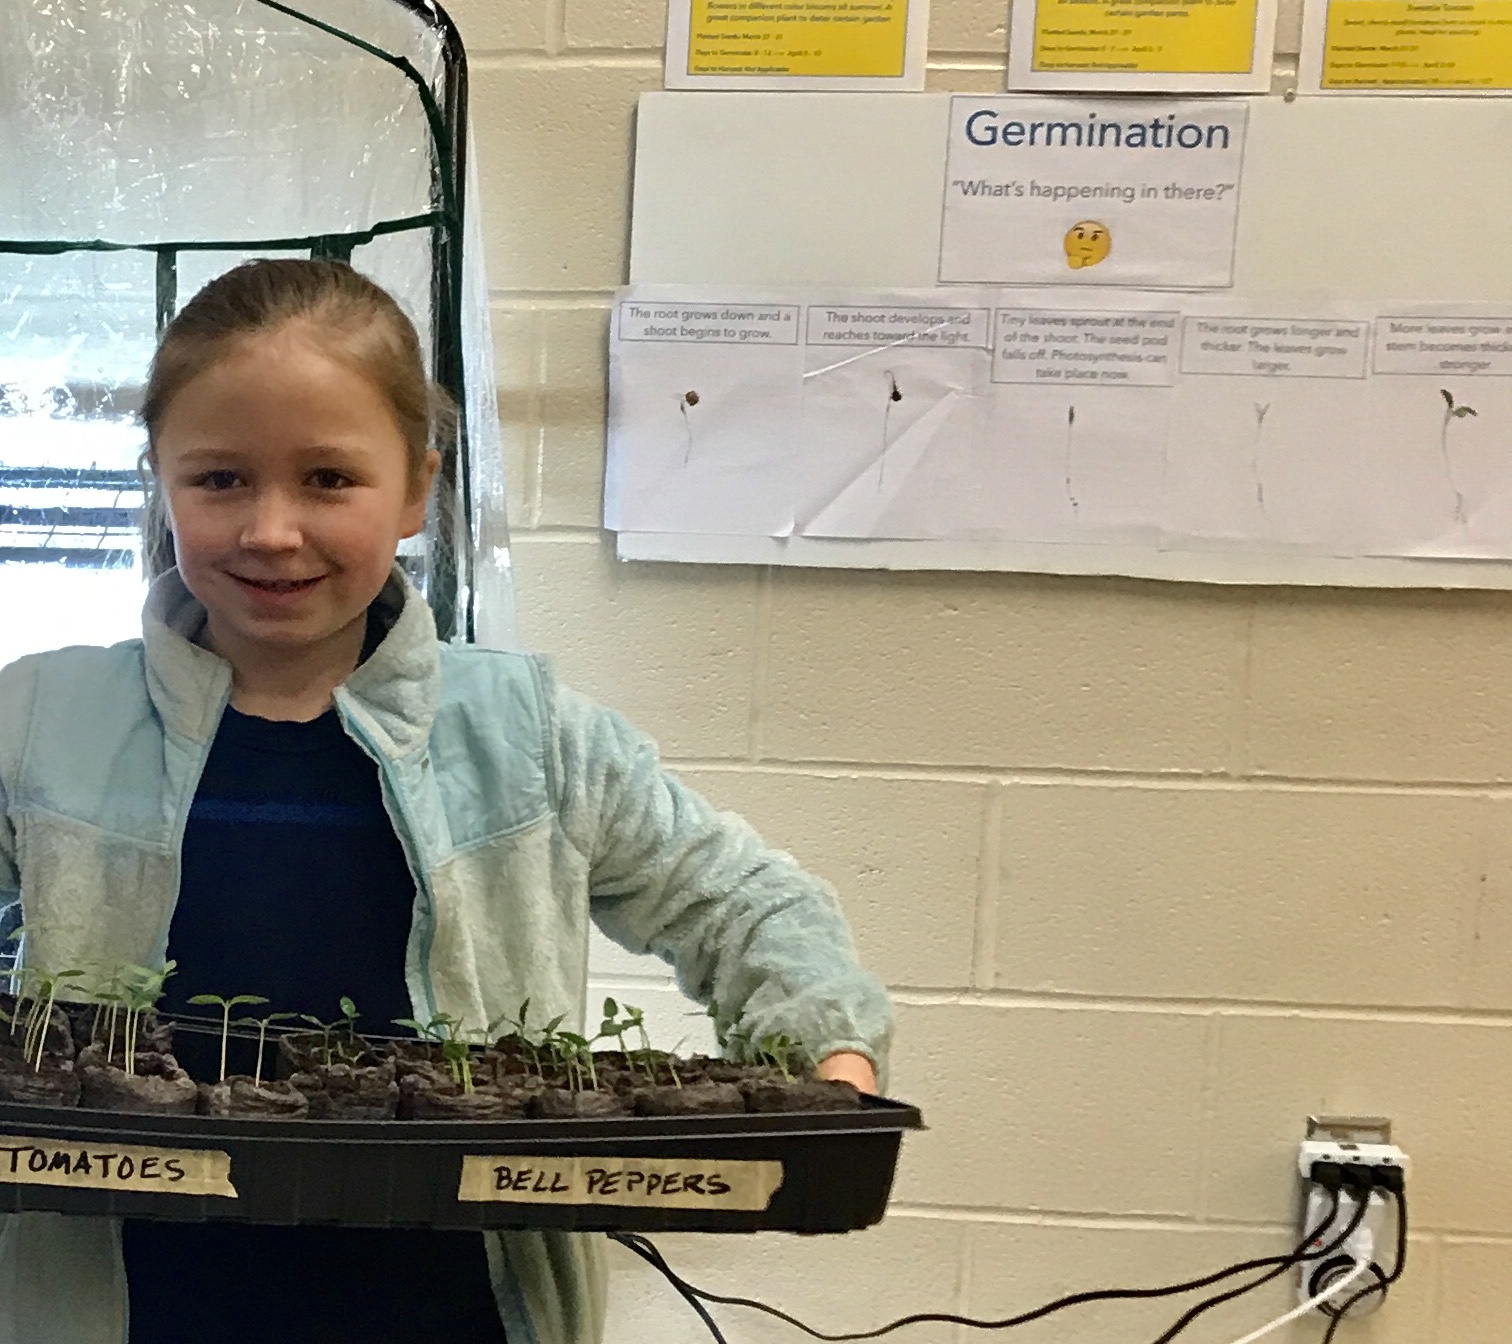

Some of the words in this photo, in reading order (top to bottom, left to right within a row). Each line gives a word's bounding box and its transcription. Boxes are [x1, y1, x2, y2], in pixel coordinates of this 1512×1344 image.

[965, 109, 1230, 150] Germination
[1029, 180, 1136, 204] happening
[1141, 182, 1159, 200] in
[629, 307, 651, 319] The
[654, 308, 678, 320] root
[681, 309, 718, 323] grows
[720, 308, 755, 321] down
[757, 310, 781, 322] and
[826, 311, 849, 323] The
[851, 312, 886, 324] shoot
[889, 312, 944, 327] develops
[1000, 313, 1026, 327] Tiny
[1028, 314, 1067, 327] leaves
[1149, 316, 1176, 329] end
[643, 325, 677, 337] shoot
[680, 326, 721, 340] begins
[723, 328, 737, 339] to
[823, 328, 871, 341] reaches
[1389, 322, 1424, 334] More
[1003, 331, 1018, 343] of
[1019, 331, 1039, 344] the
[1083, 332, 1106, 344] The
[1418, 339, 1478, 353] becomes
[1050, 349, 1144, 364] Photosynthesis
[1064, 368, 1099, 380] place
[493, 1165, 569, 1193] BELL
[584, 1167, 732, 1196] PEPPERS
